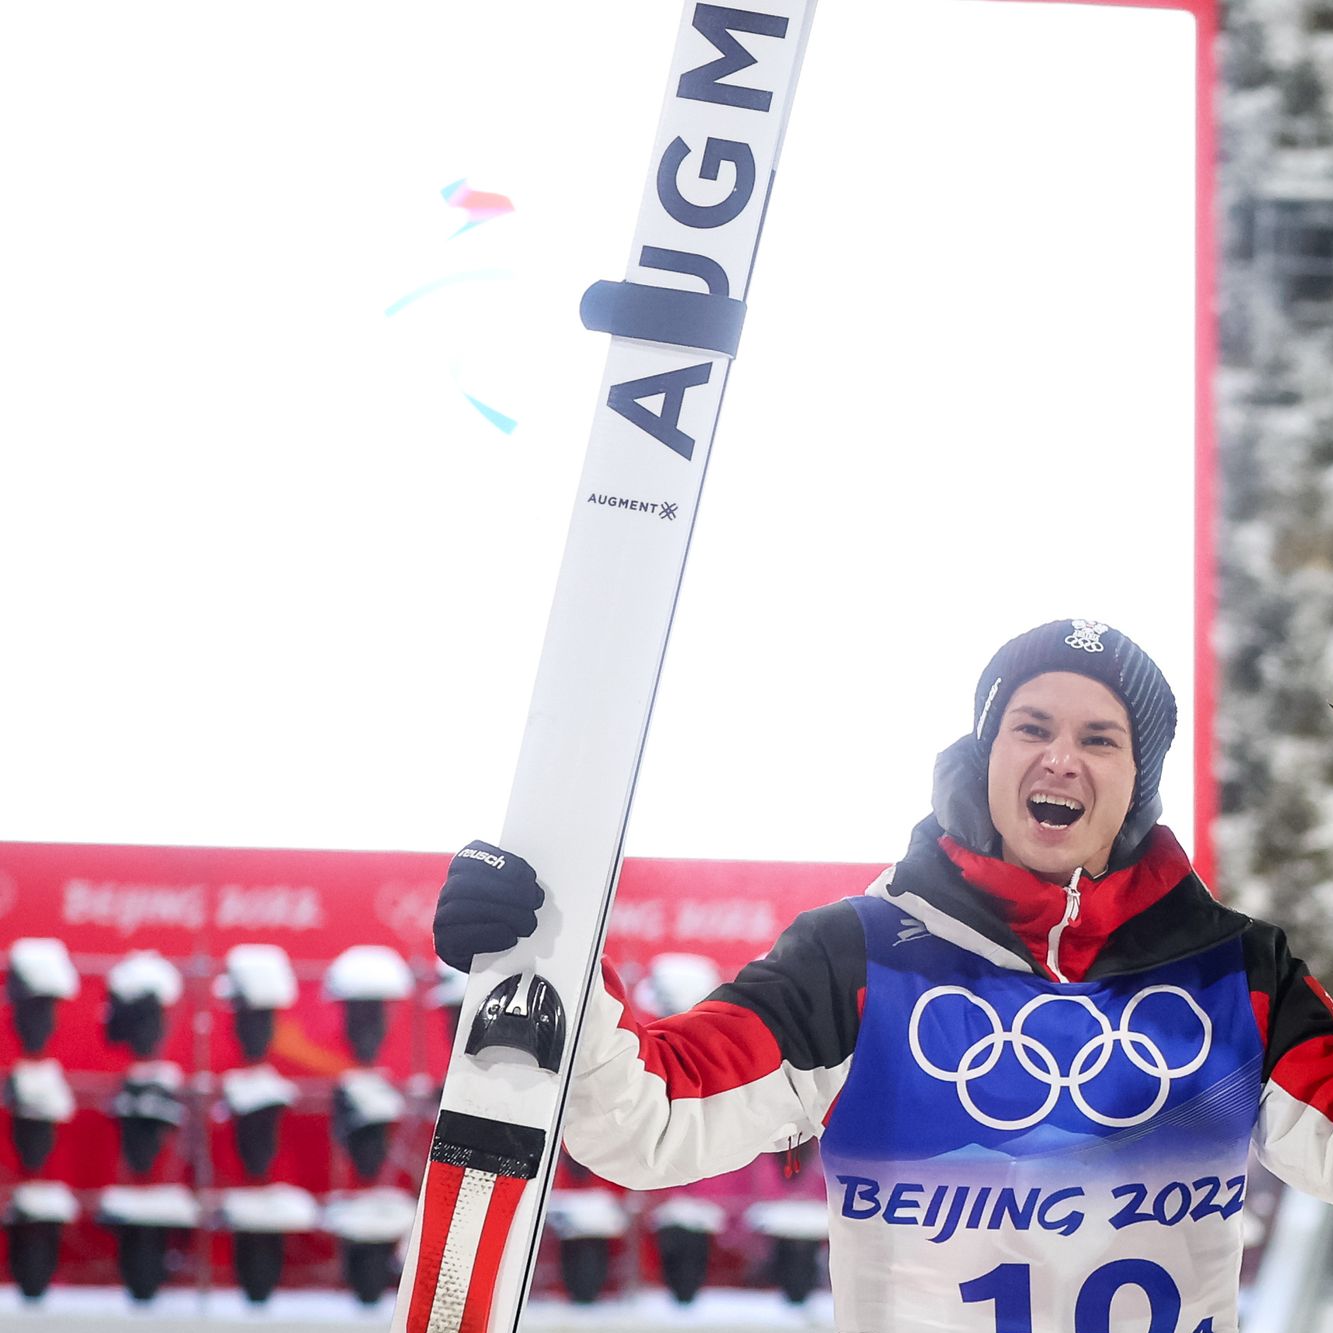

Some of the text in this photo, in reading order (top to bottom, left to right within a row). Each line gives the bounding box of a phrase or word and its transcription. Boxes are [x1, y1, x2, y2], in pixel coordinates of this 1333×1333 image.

[587, 493, 658, 514] AUGMENT
[457, 848, 506, 870] reusch
[836, 1173, 1246, 1244] BEIJING 2022
